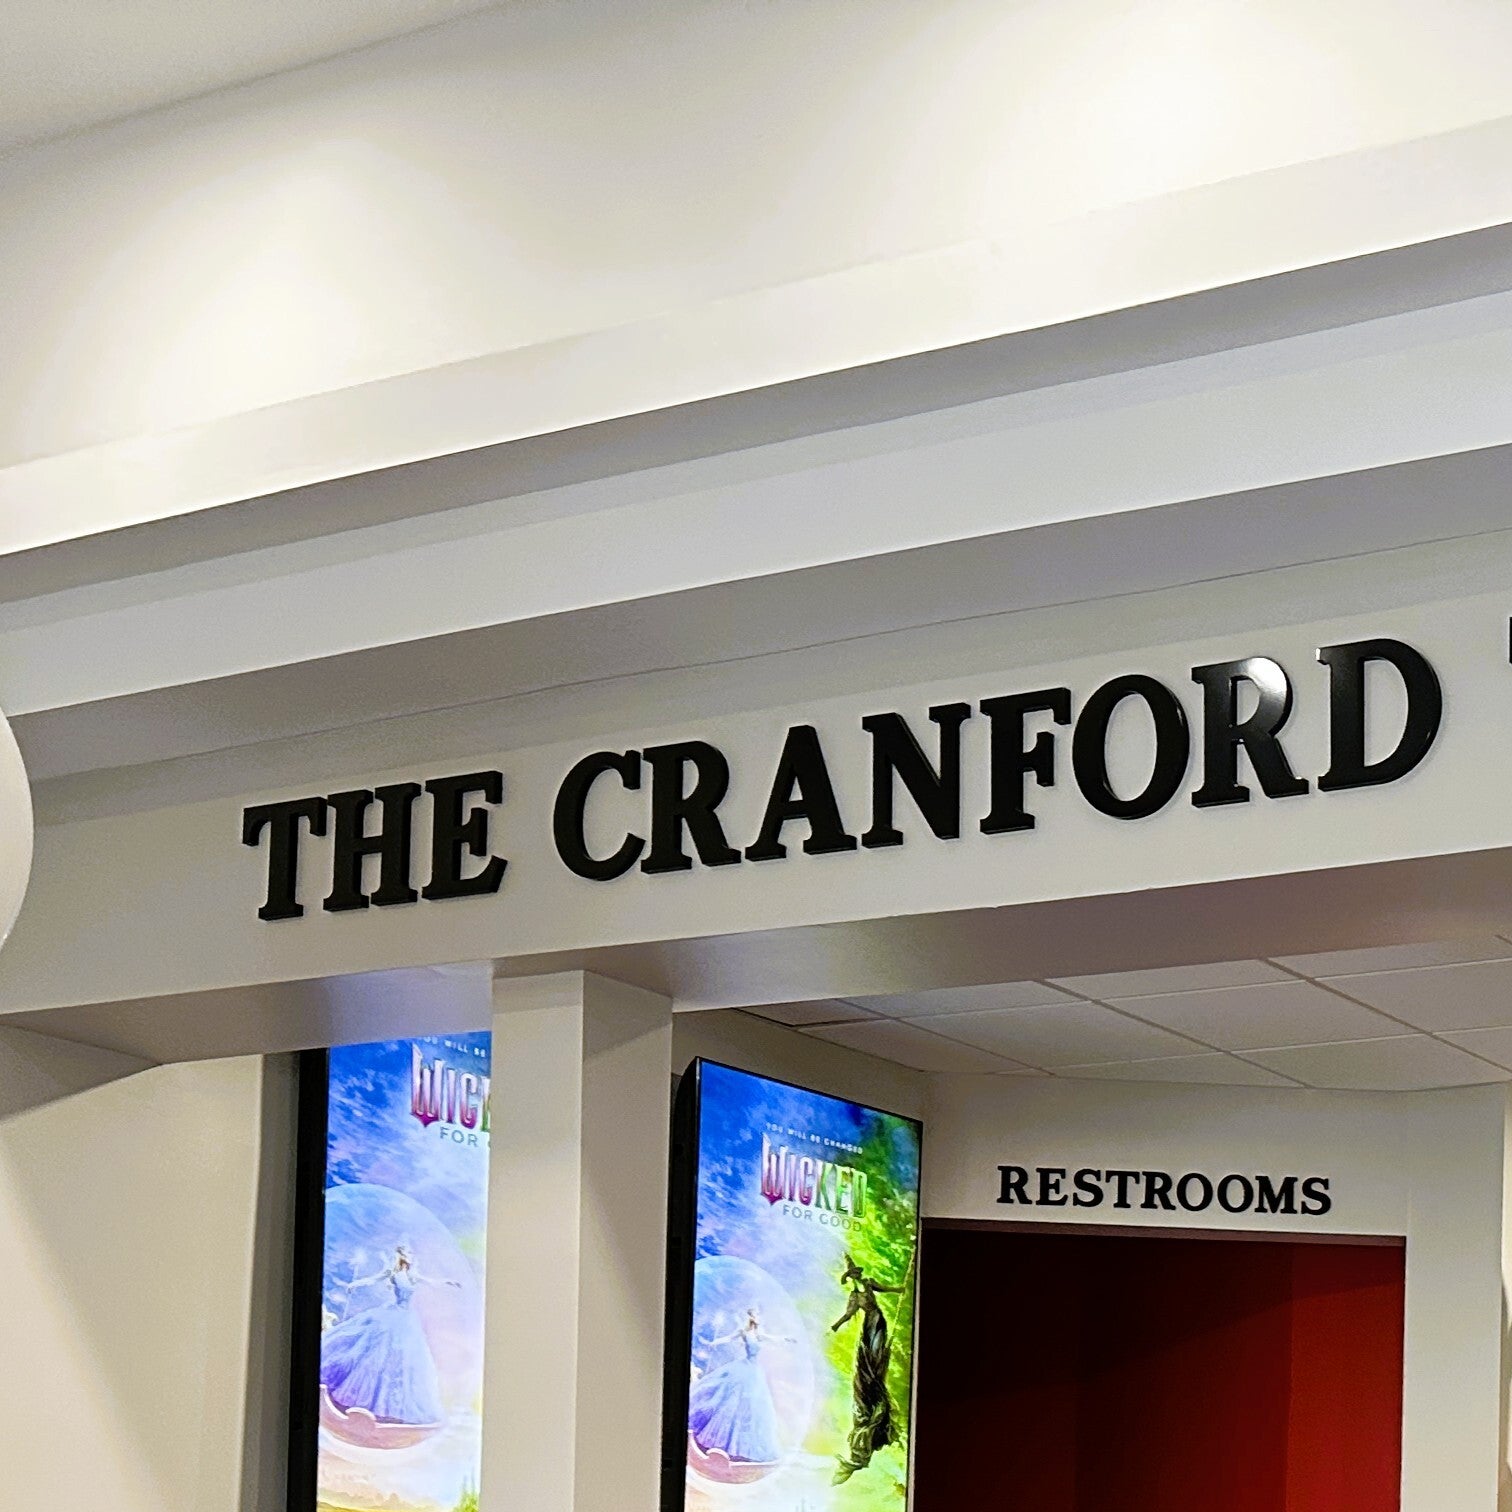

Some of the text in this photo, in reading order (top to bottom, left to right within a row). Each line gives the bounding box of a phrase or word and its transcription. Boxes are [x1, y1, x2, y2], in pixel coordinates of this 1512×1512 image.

[242, 770, 508, 921] THE
[553, 638, 1443, 881] CRANFORD
[439, 1127, 478, 1147] FOR
[761, 1132, 868, 1218] WICKED
[997, 1166, 1331, 1216] RESTROOMS
[783, 1204, 862, 1231] FOR GOOD
